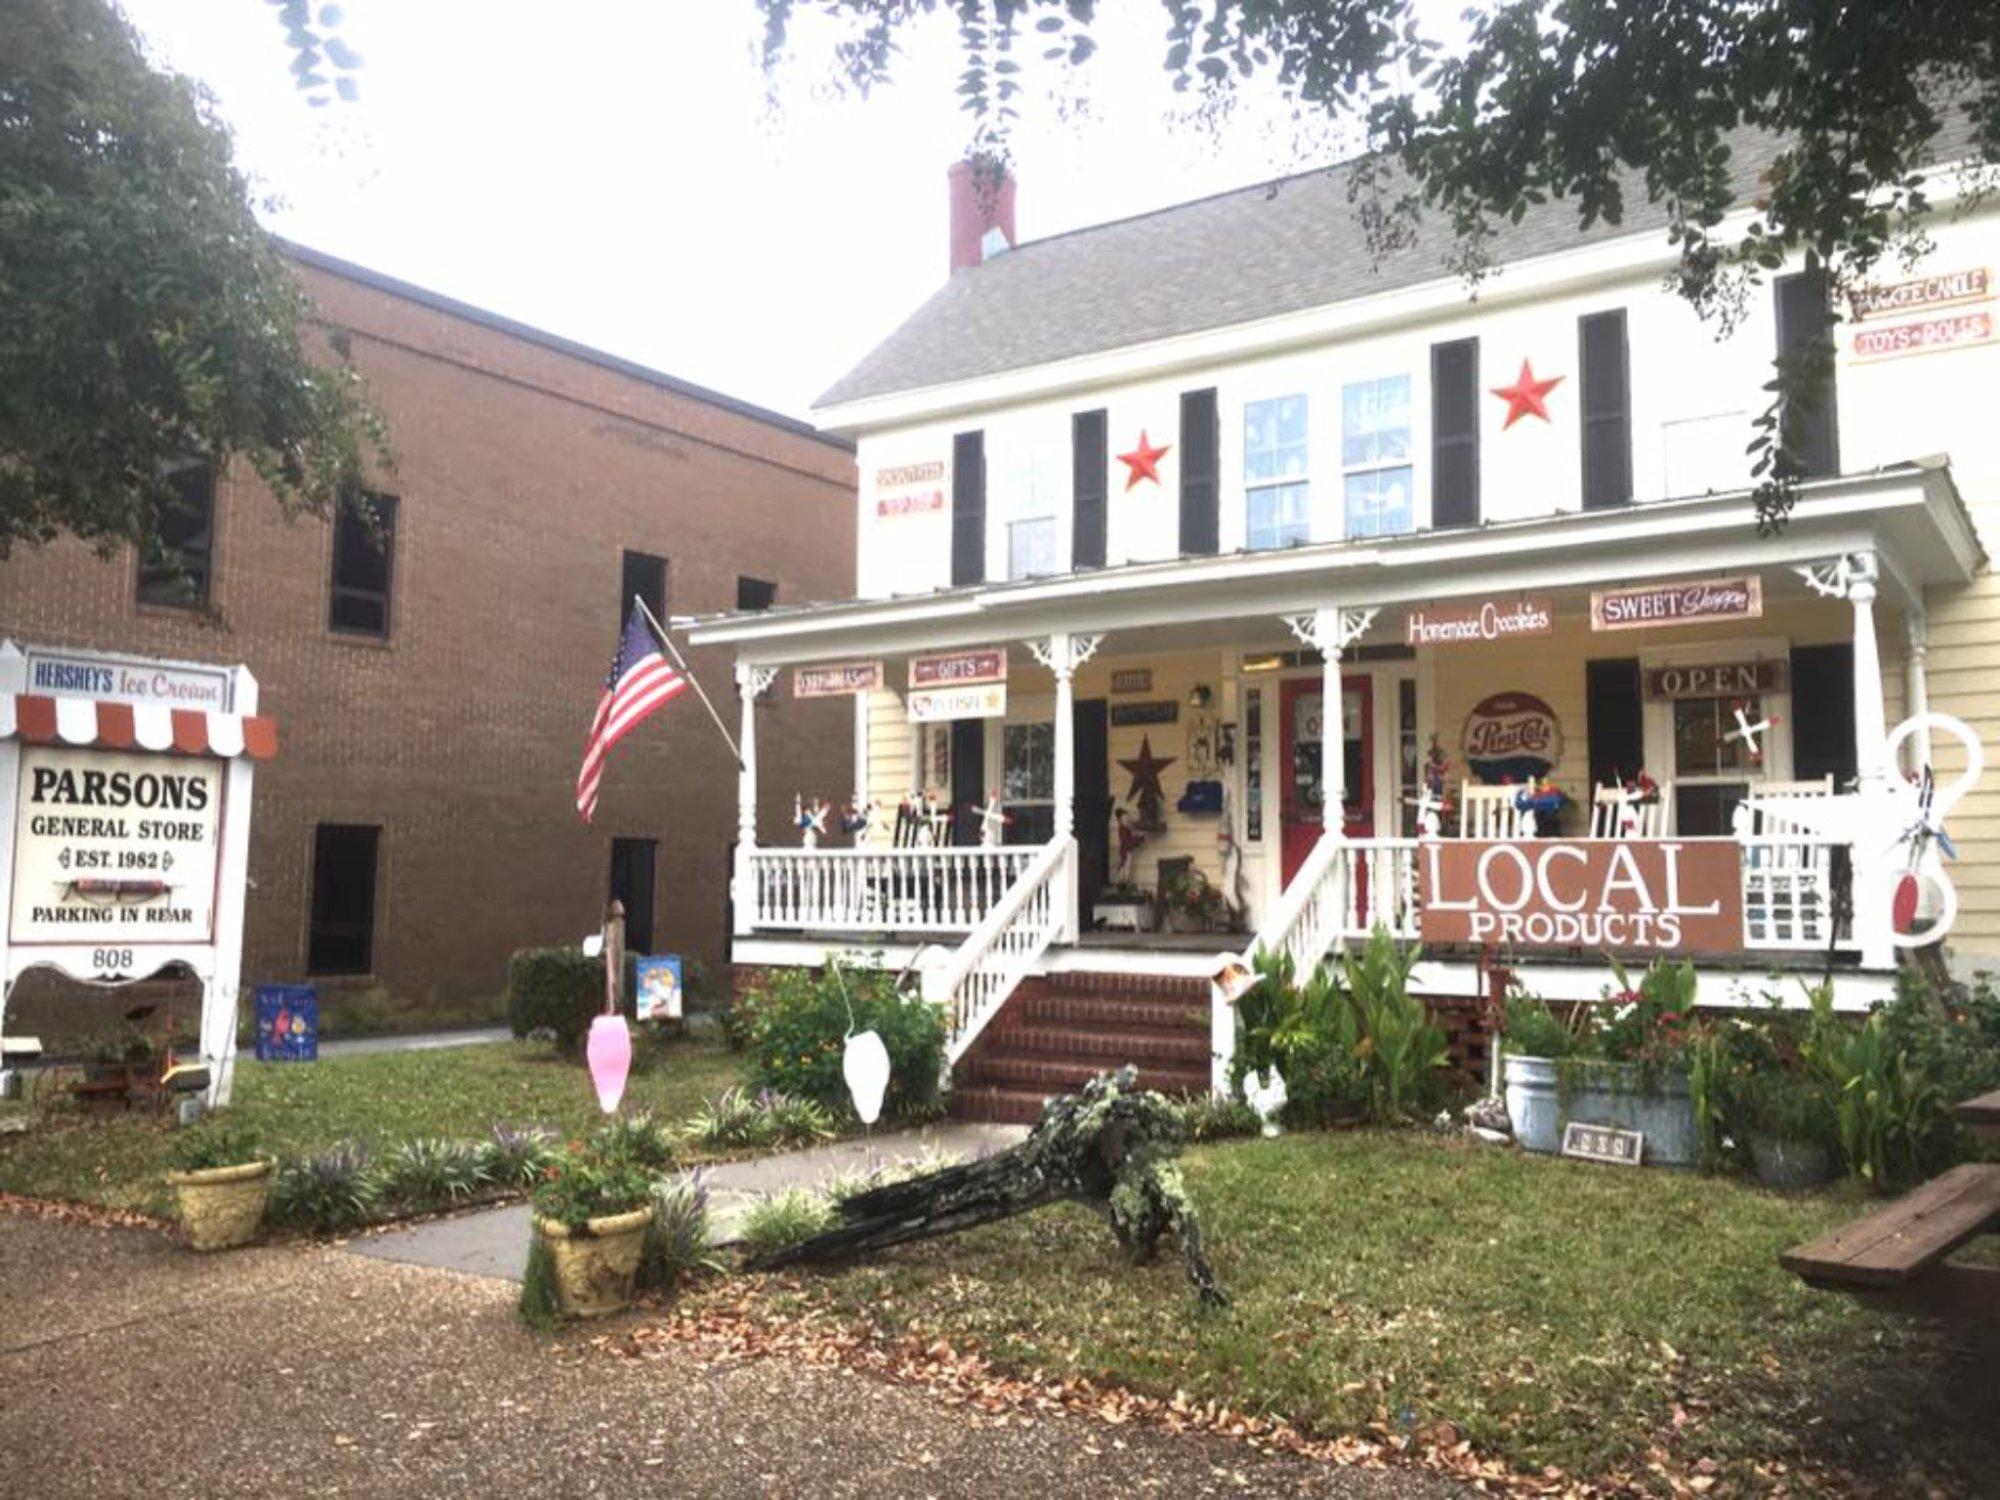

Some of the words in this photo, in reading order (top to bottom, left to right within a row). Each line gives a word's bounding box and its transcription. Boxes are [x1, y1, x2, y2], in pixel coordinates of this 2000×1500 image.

[1864, 328, 1911, 353] TOYS
[1605, 592, 1681, 620] SWEET
[1410, 612, 1480, 643] Homemade
[938, 658, 976, 680] GIFTS
[1662, 667, 1760, 694] OPEN
[120, 670, 148, 695] Ice
[152, 673, 219, 701] Cream
[32, 768, 208, 811] PARSONS
[31, 817, 129, 837] GENERAL
[138, 820, 204, 841] STORE
[75, 851, 113, 868] EST.
[117, 852, 158, 869] 1982
[1425, 843, 1721, 915] LOCAL
[32, 907, 114, 924] PARKING
[120, 908, 139, 924] IN
[145, 907, 193, 924] REAR
[1468, 912, 1682, 947] PRODUCTS
[93, 950, 133, 969] 808
